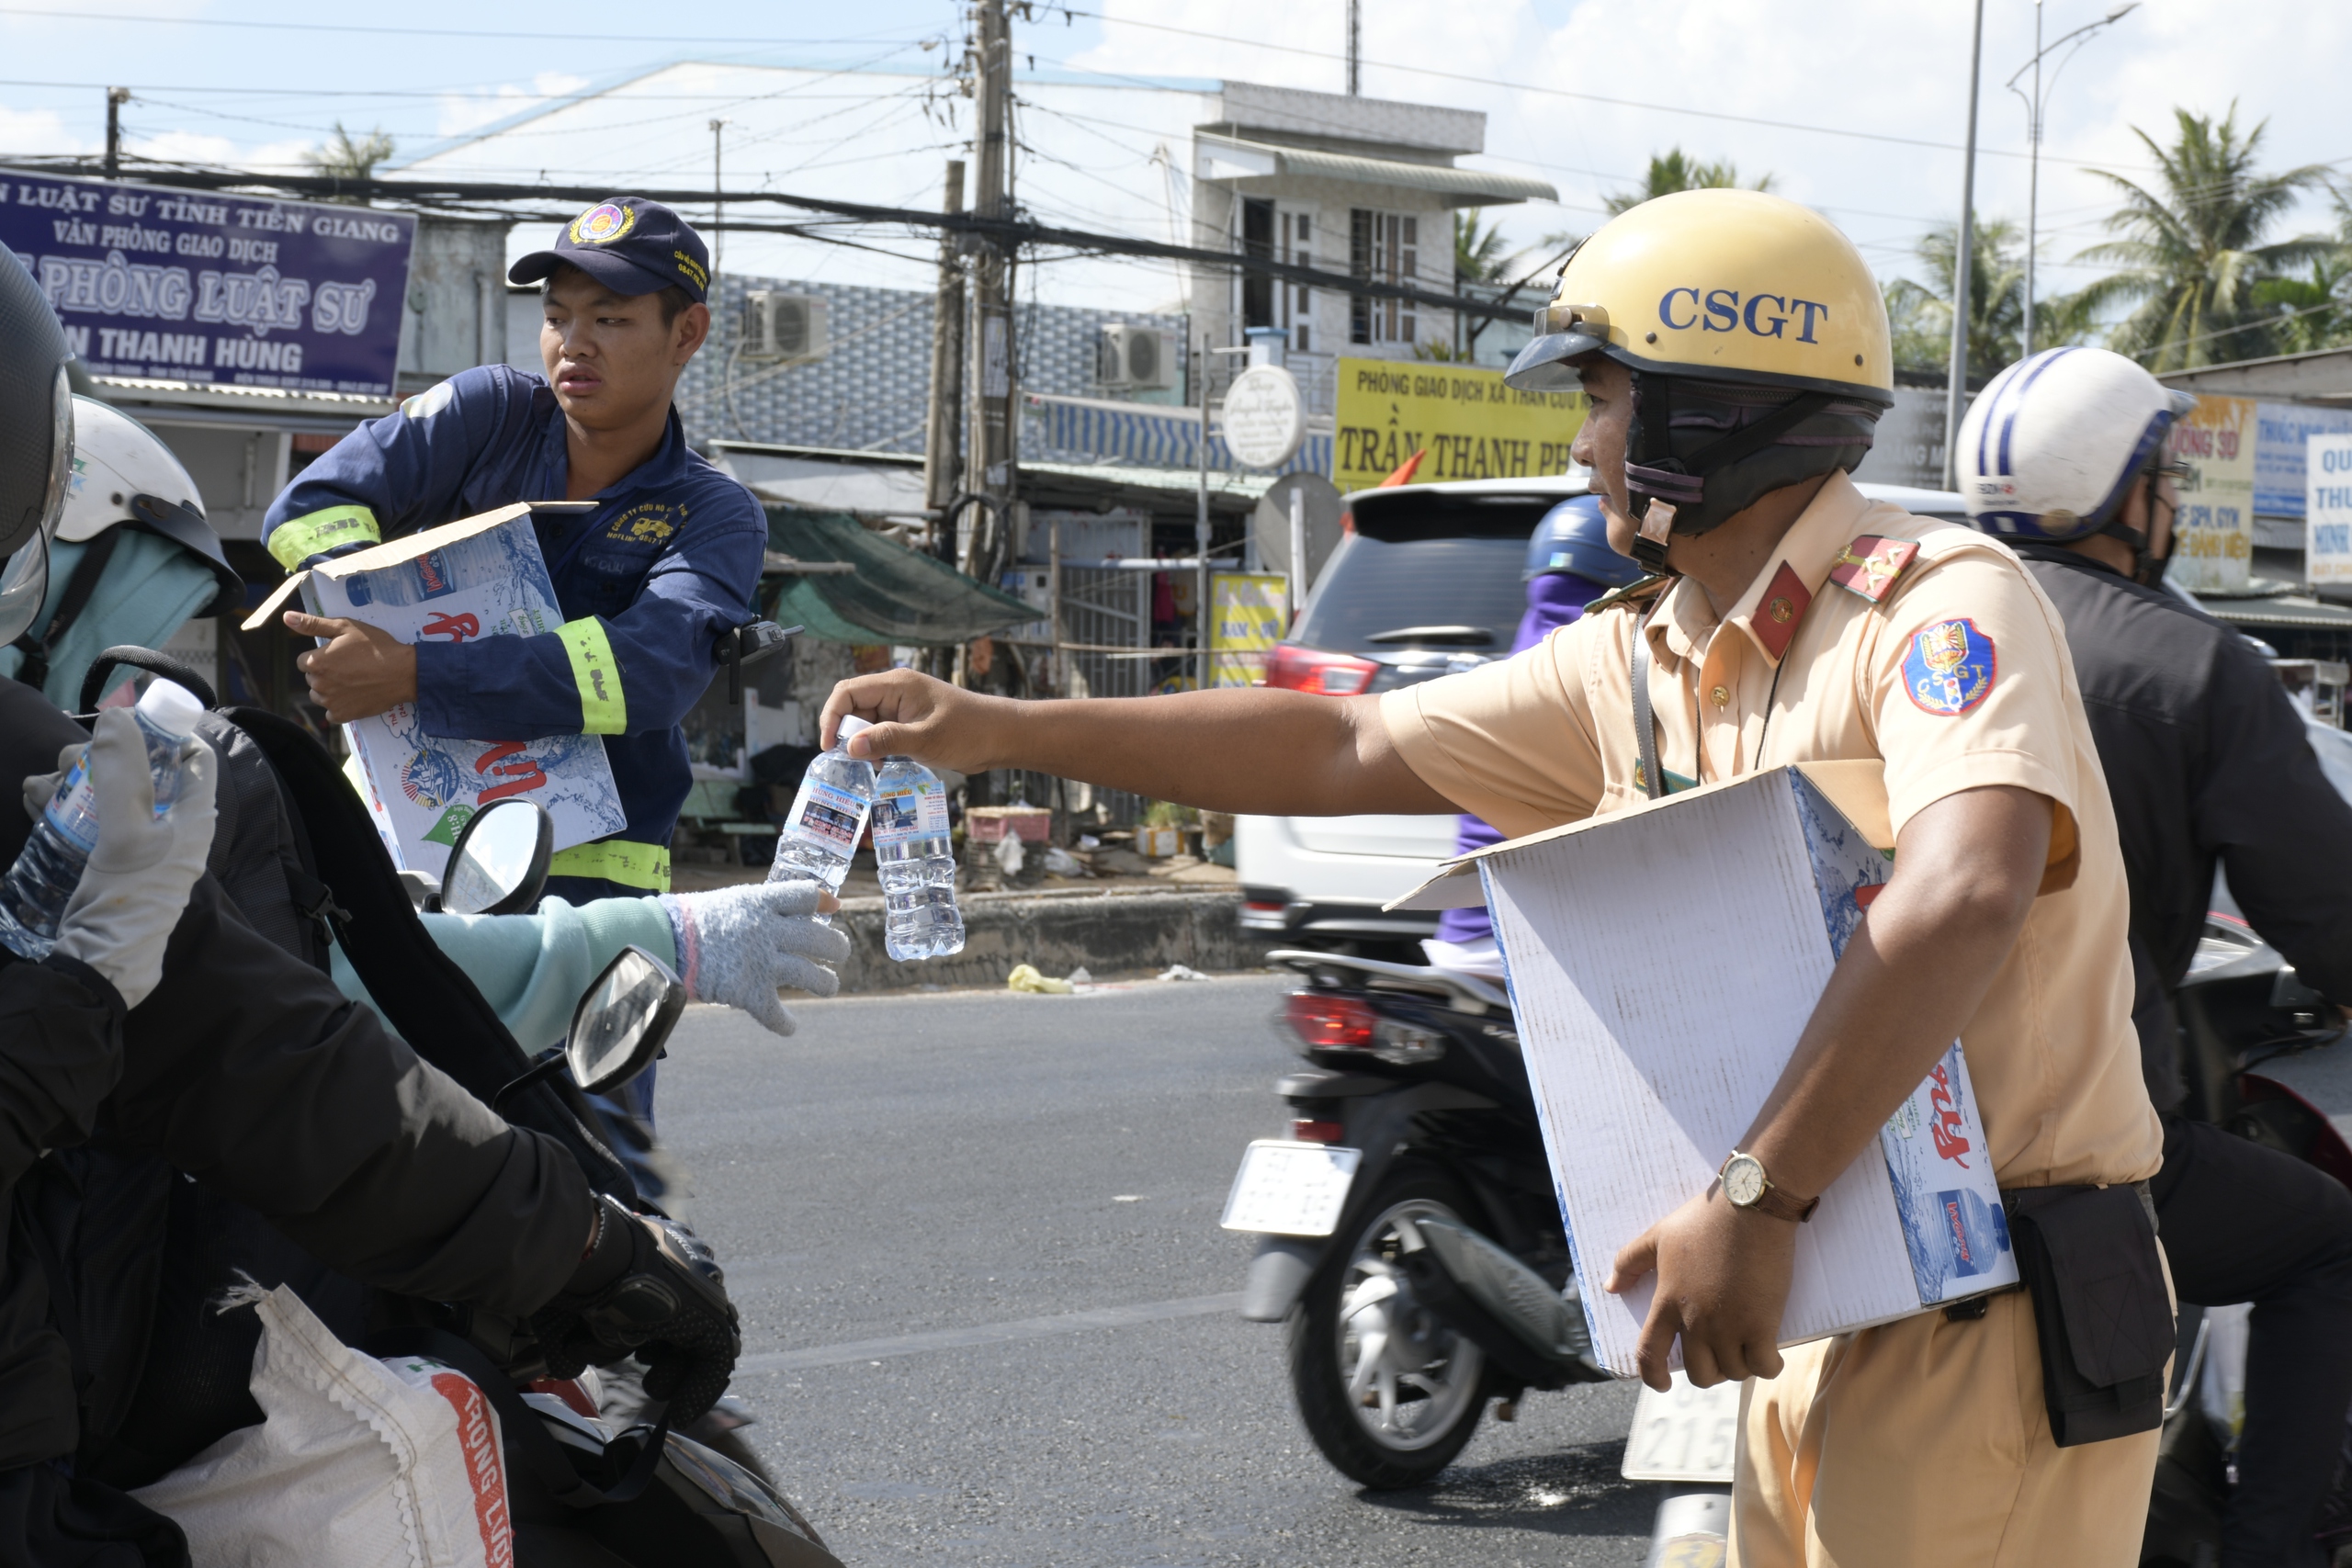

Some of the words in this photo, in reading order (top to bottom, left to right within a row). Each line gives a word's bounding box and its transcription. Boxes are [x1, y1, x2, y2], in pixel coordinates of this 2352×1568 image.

[17, 185, 101, 214] LUẬT
[108, 194, 151, 217] SƯ
[312, 217, 400, 243] GIANG
[53, 218, 96, 244] VĂN
[100, 223, 172, 254] PHÒNG
[175, 232, 225, 258] GIAO
[229, 240, 279, 266] DỊCH
[40, 249, 190, 320] PHÒNG
[194, 265, 311, 337] LUẬT
[312, 277, 377, 335] SƯ
[1659, 287, 1829, 345] CSGT
[98, 327, 208, 367] THANH
[214, 333, 304, 373] HÙNG
[1358, 367, 1409, 396] PHÒNG
[1415, 376, 1448, 398] GIAO
[1453, 378, 1484, 405] DỊCH
[1340, 403, 1425, 476] TRẦN
[1433, 434, 1532, 479] THANH
[1917, 663, 1984, 694] CSGT
[462, 1387, 498, 1495] TRỌNG
[485, 1498, 514, 1568] LƯỢ
